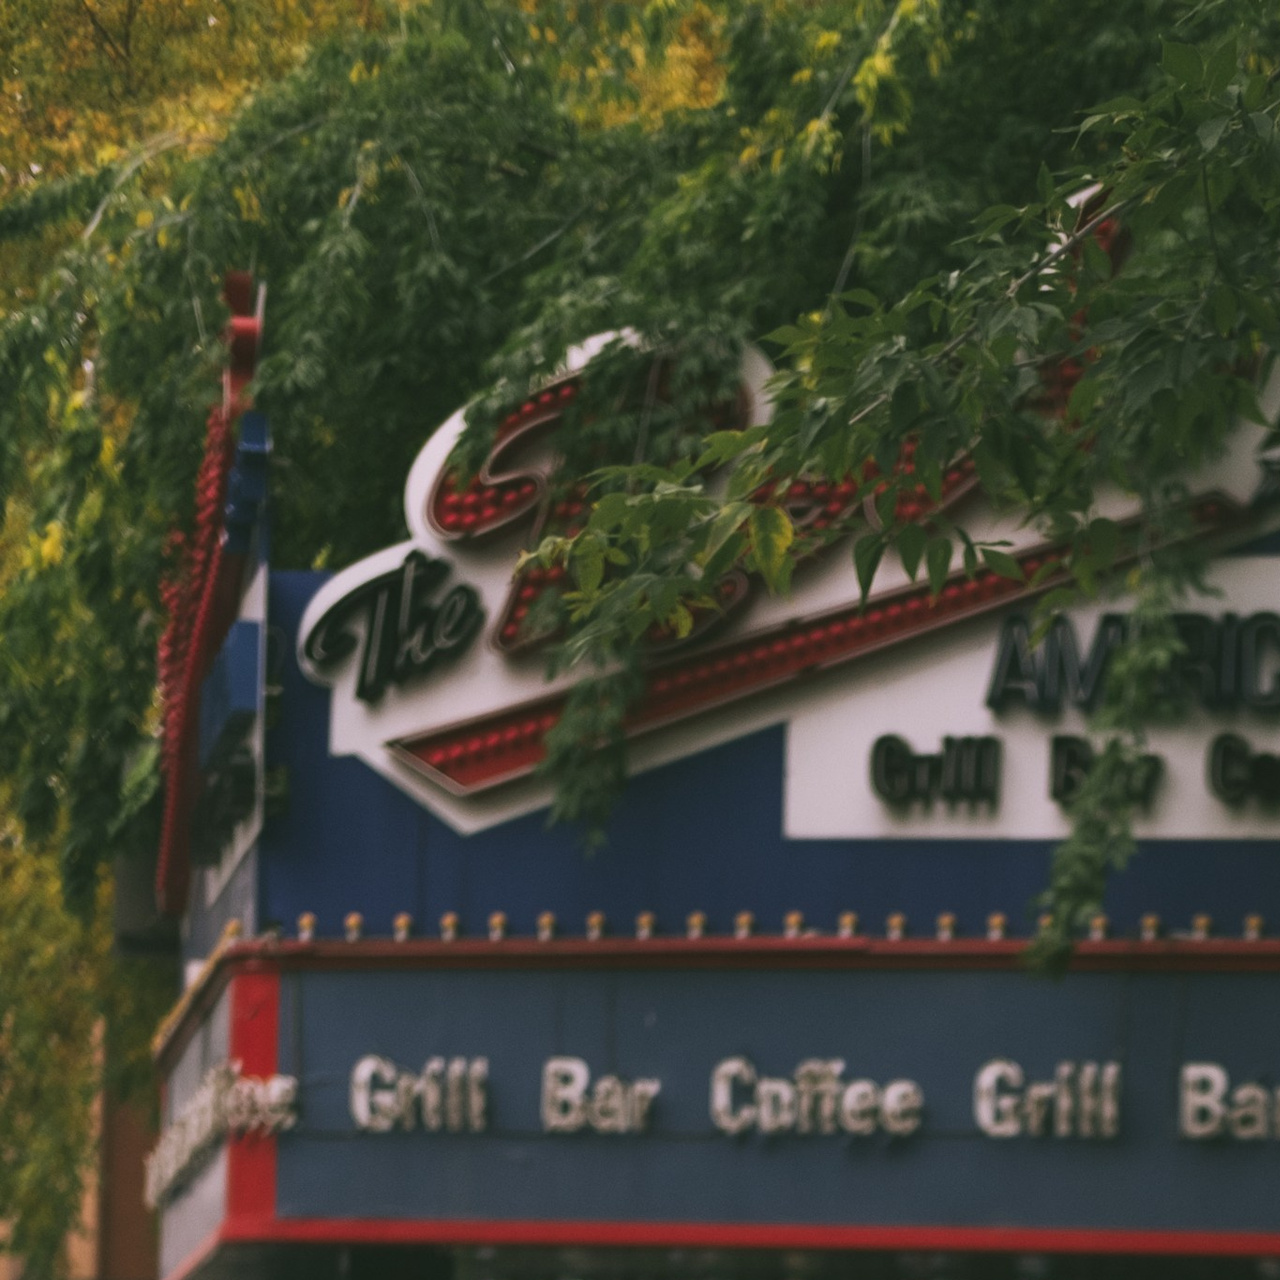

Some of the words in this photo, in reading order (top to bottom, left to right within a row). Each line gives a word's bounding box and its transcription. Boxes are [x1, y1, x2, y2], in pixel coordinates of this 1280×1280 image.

[303, 548, 486, 704] The
[350, 1055, 488, 1133] Grill
[541, 1057, 661, 1131] Bar
[712, 1057, 922, 1134] Coffee
[974, 1059, 1121, 1138] Grill
